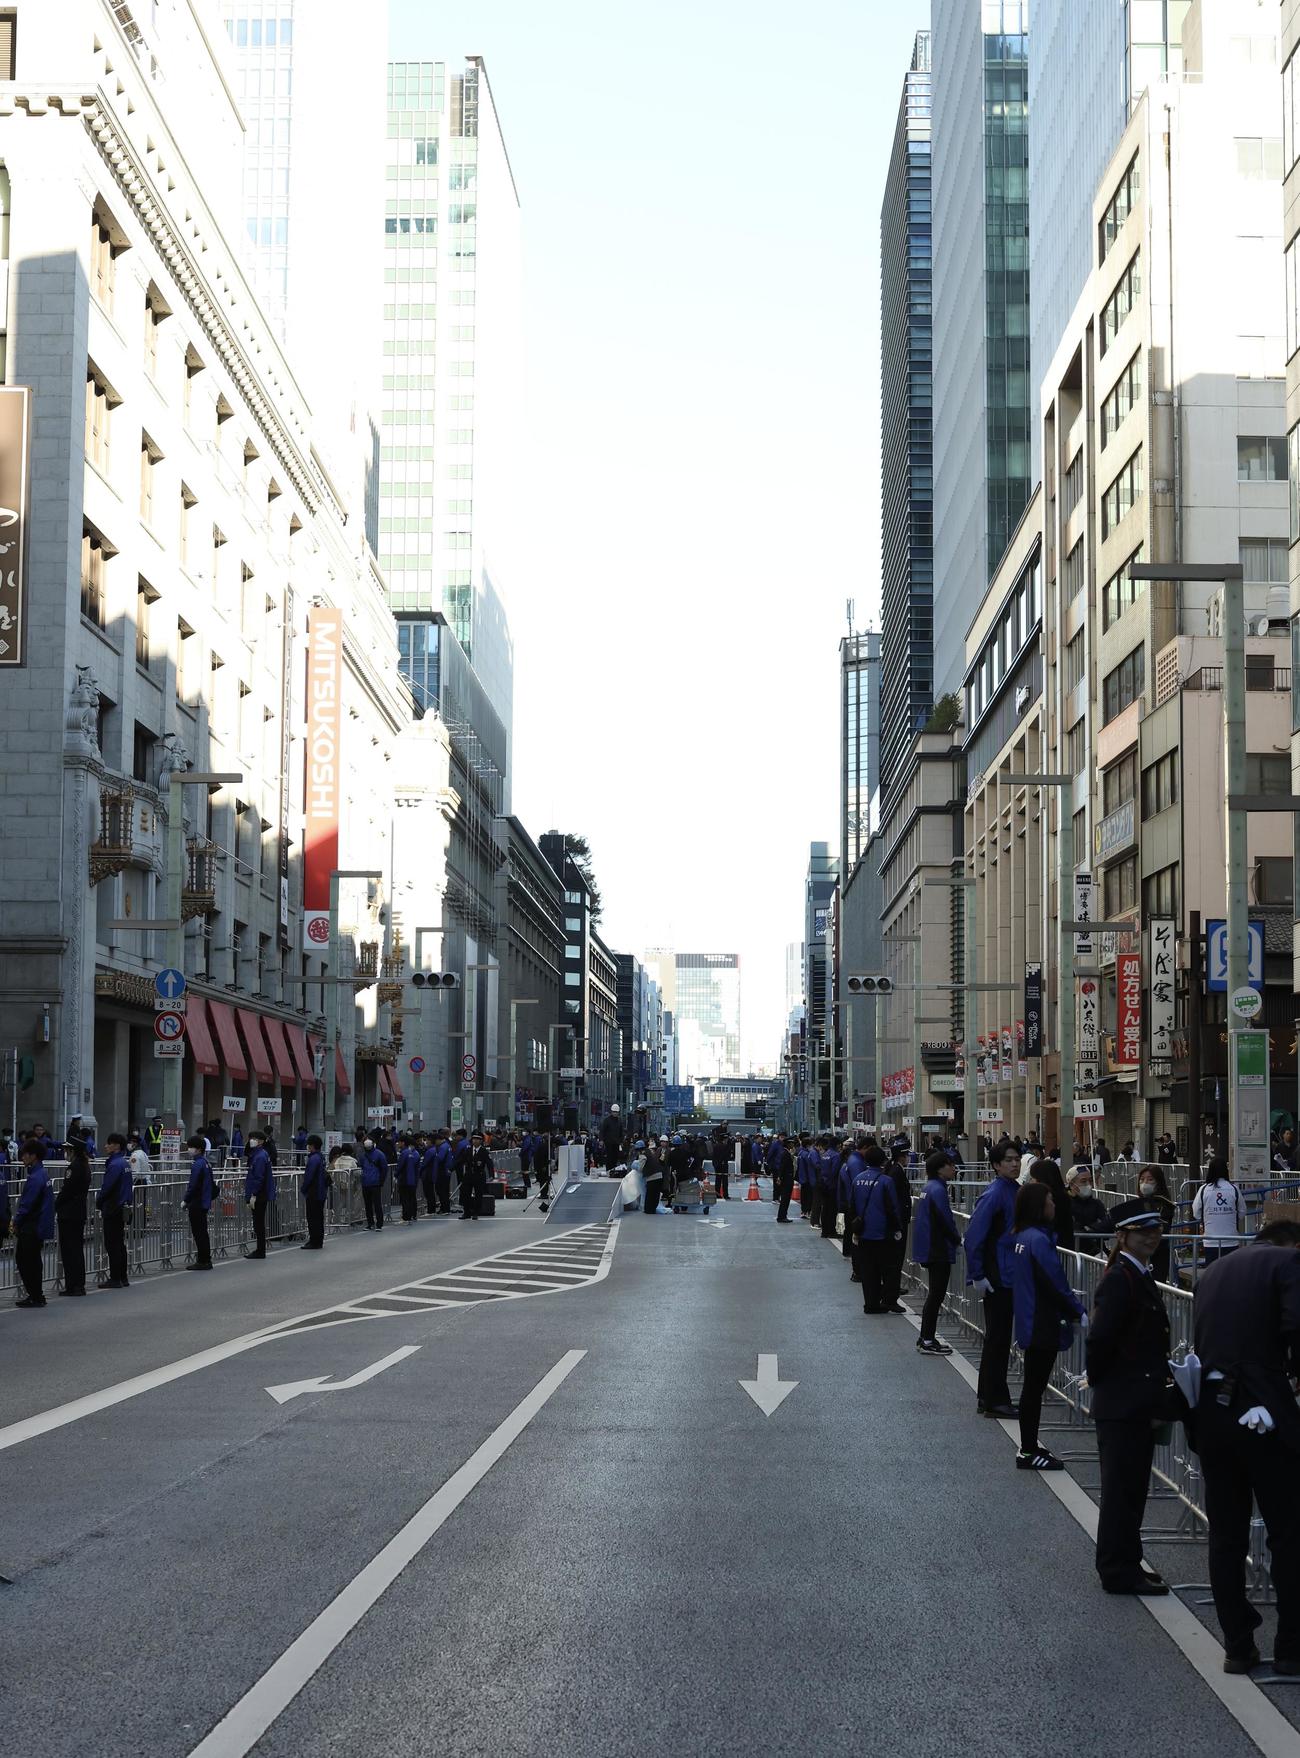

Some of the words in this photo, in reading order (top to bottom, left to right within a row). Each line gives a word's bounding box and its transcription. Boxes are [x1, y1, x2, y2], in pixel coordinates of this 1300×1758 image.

[312, 622, 337, 819] MITSUKOSHI
[1123, 960, 1140, 1059] 処方せん受付
[1081, 1051, 1097, 1059] B1F
[228, 1100, 241, 1108] W9
[1081, 1103, 1098, 1113] E10
[1014, 1242, 1026, 1255] FF
